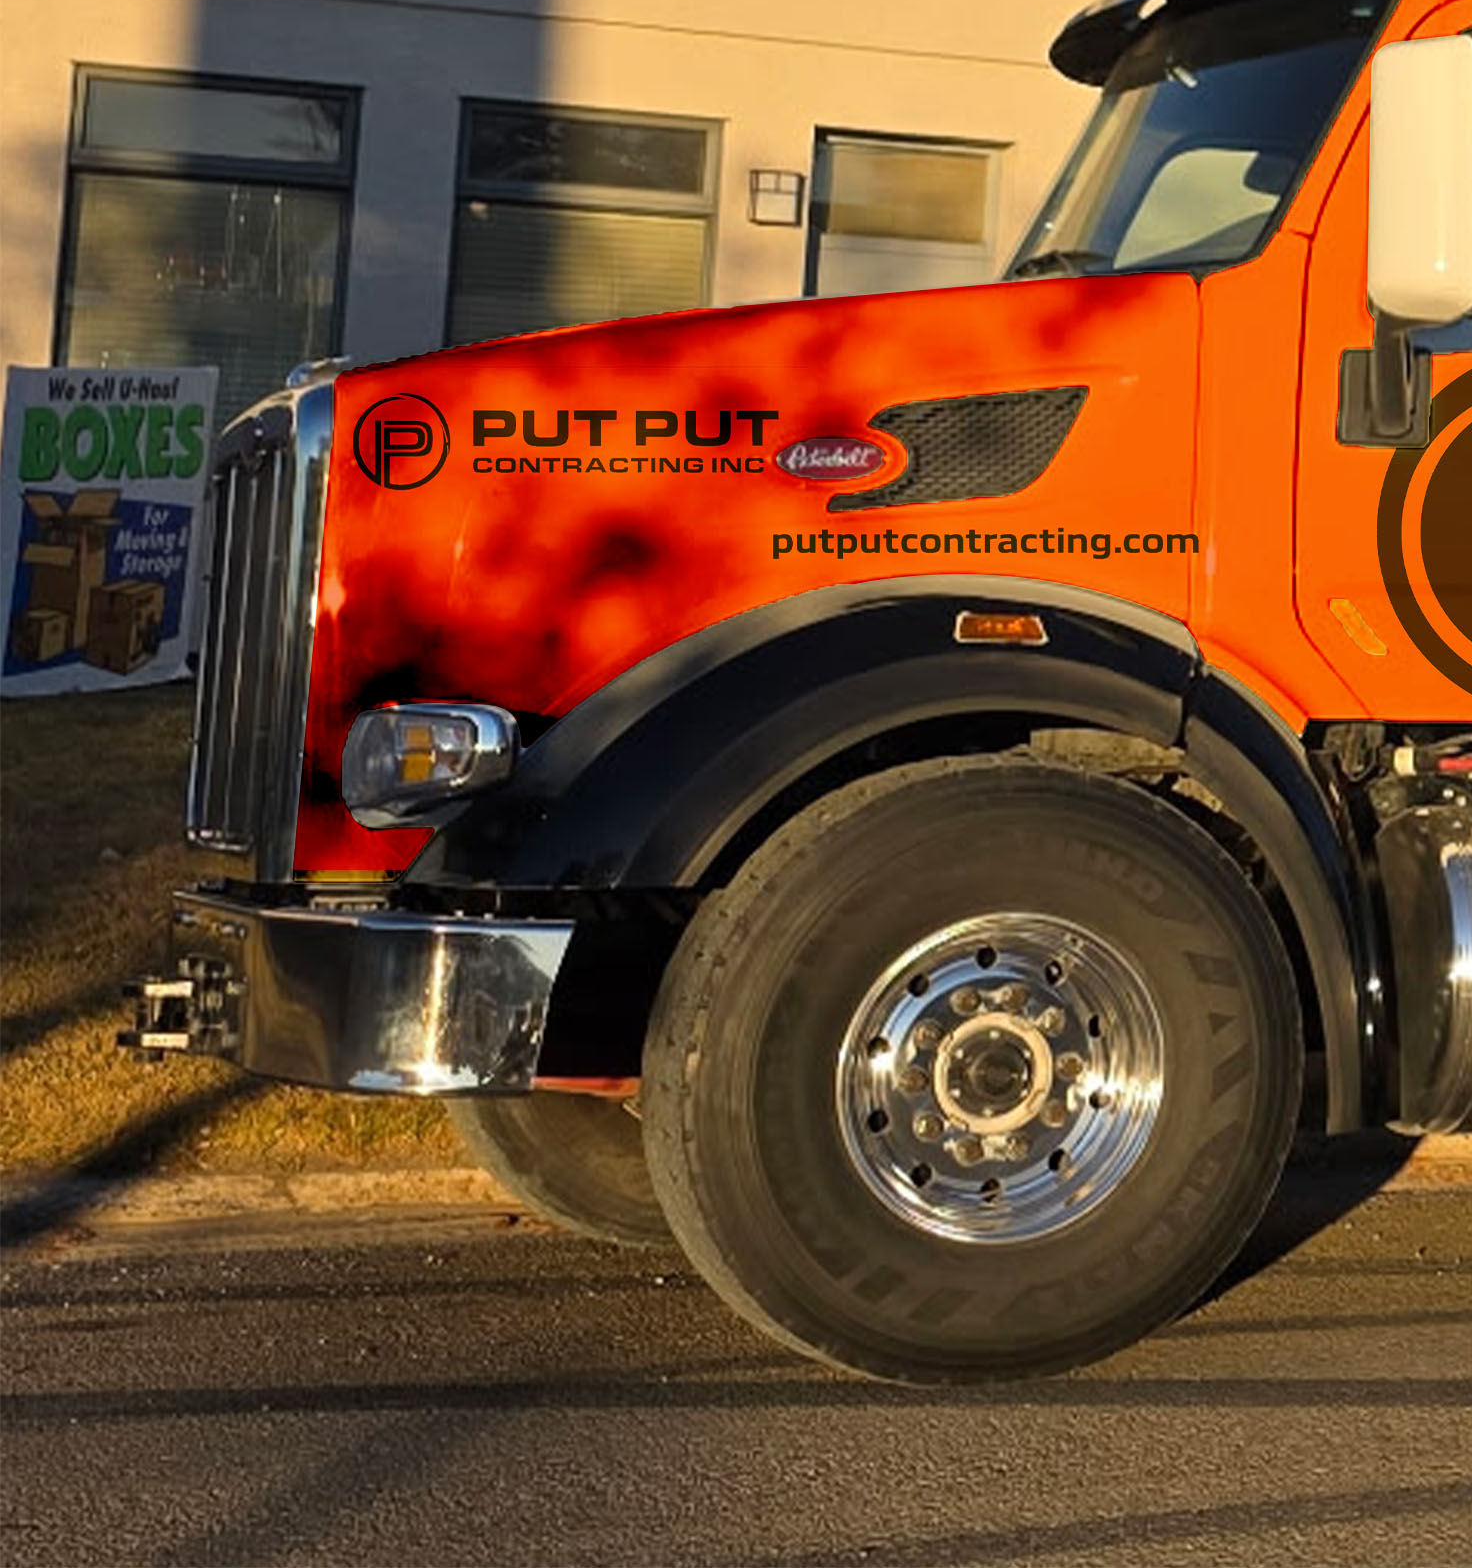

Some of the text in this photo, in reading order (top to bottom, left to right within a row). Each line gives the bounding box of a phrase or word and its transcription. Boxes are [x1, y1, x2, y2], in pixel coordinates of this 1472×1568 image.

[49, 377, 76, 402] We
[80, 376, 115, 401] Sell
[19, 403, 205, 482] BOXES
[473, 410, 779, 447] PUT PUT
[472, 457, 766, 475] CONTRACTING INC
[771, 527, 1200, 560] putputcontracting.com
